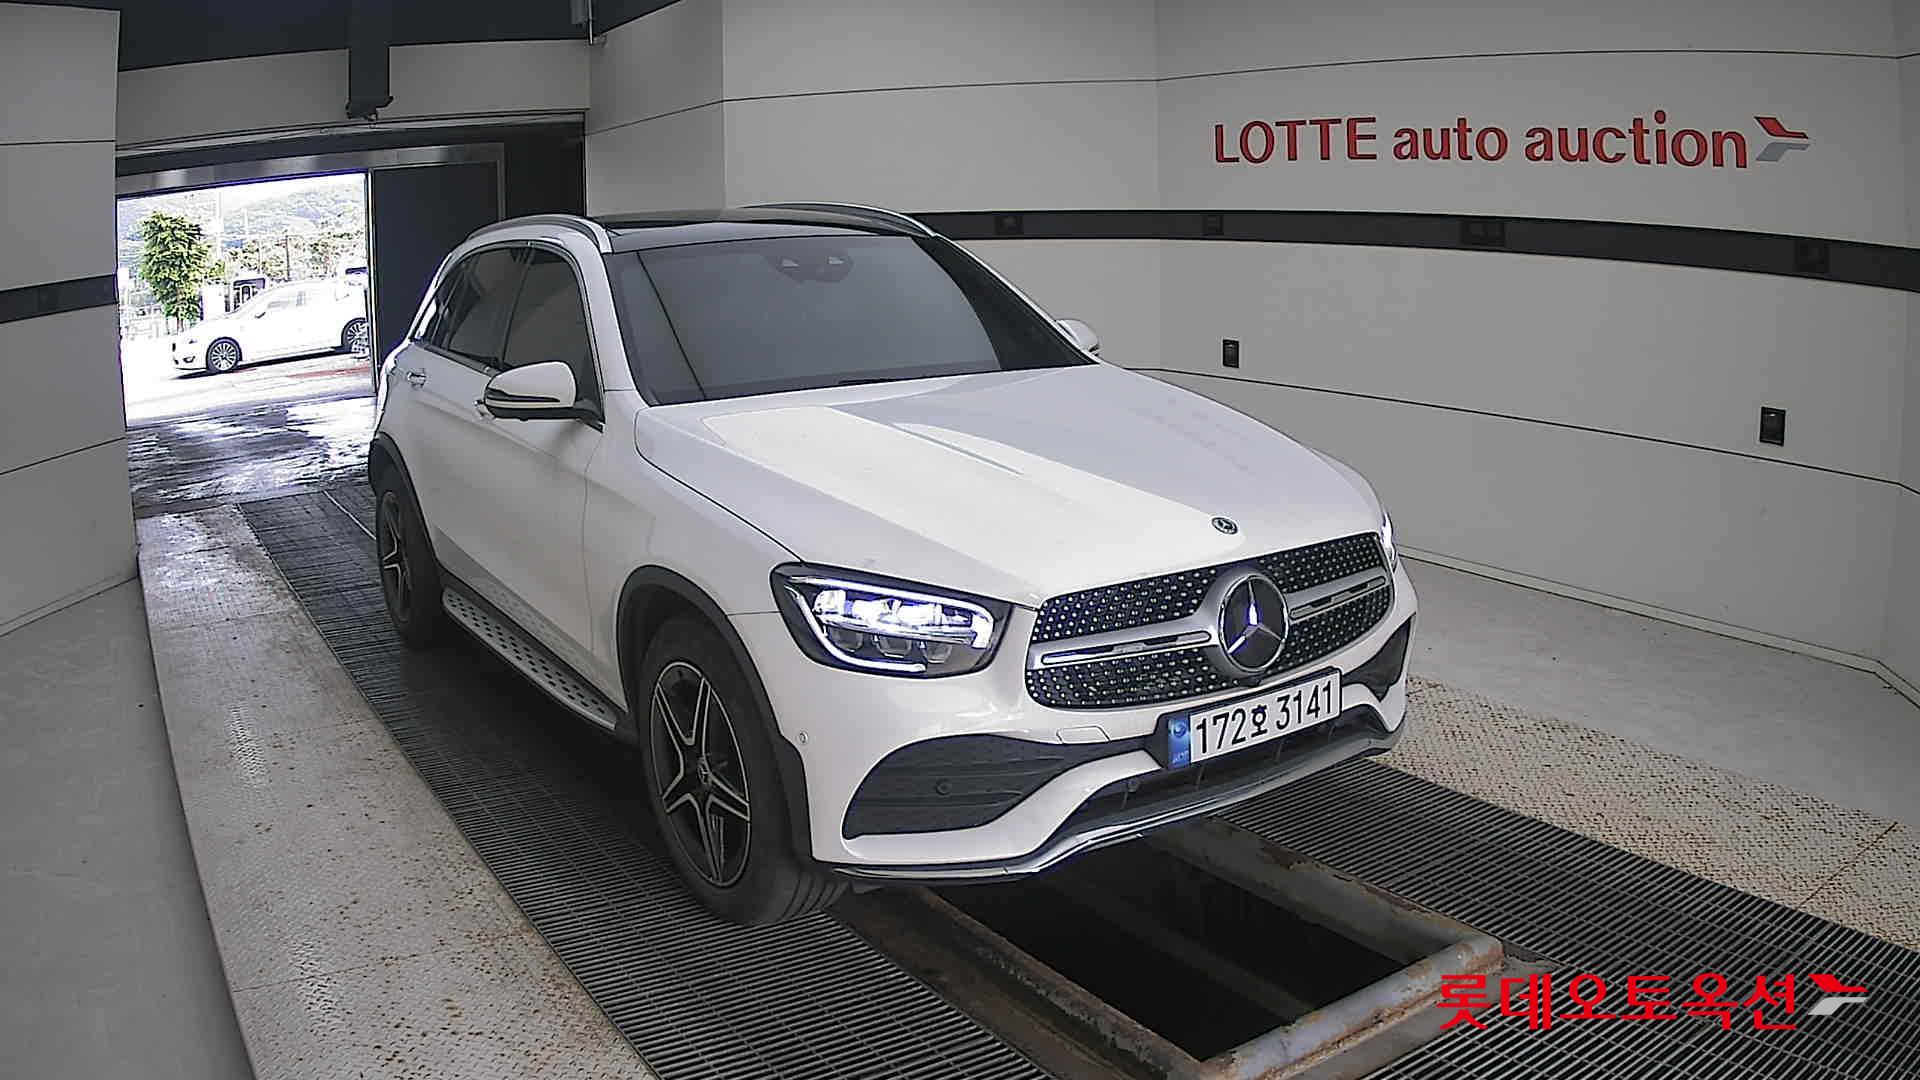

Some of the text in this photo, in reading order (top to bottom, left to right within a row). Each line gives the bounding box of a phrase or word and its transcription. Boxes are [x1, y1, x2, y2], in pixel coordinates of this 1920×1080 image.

[1214, 109, 1748, 168] LOTTE auto auction
[1196, 680, 1333, 753] 172호 3141
